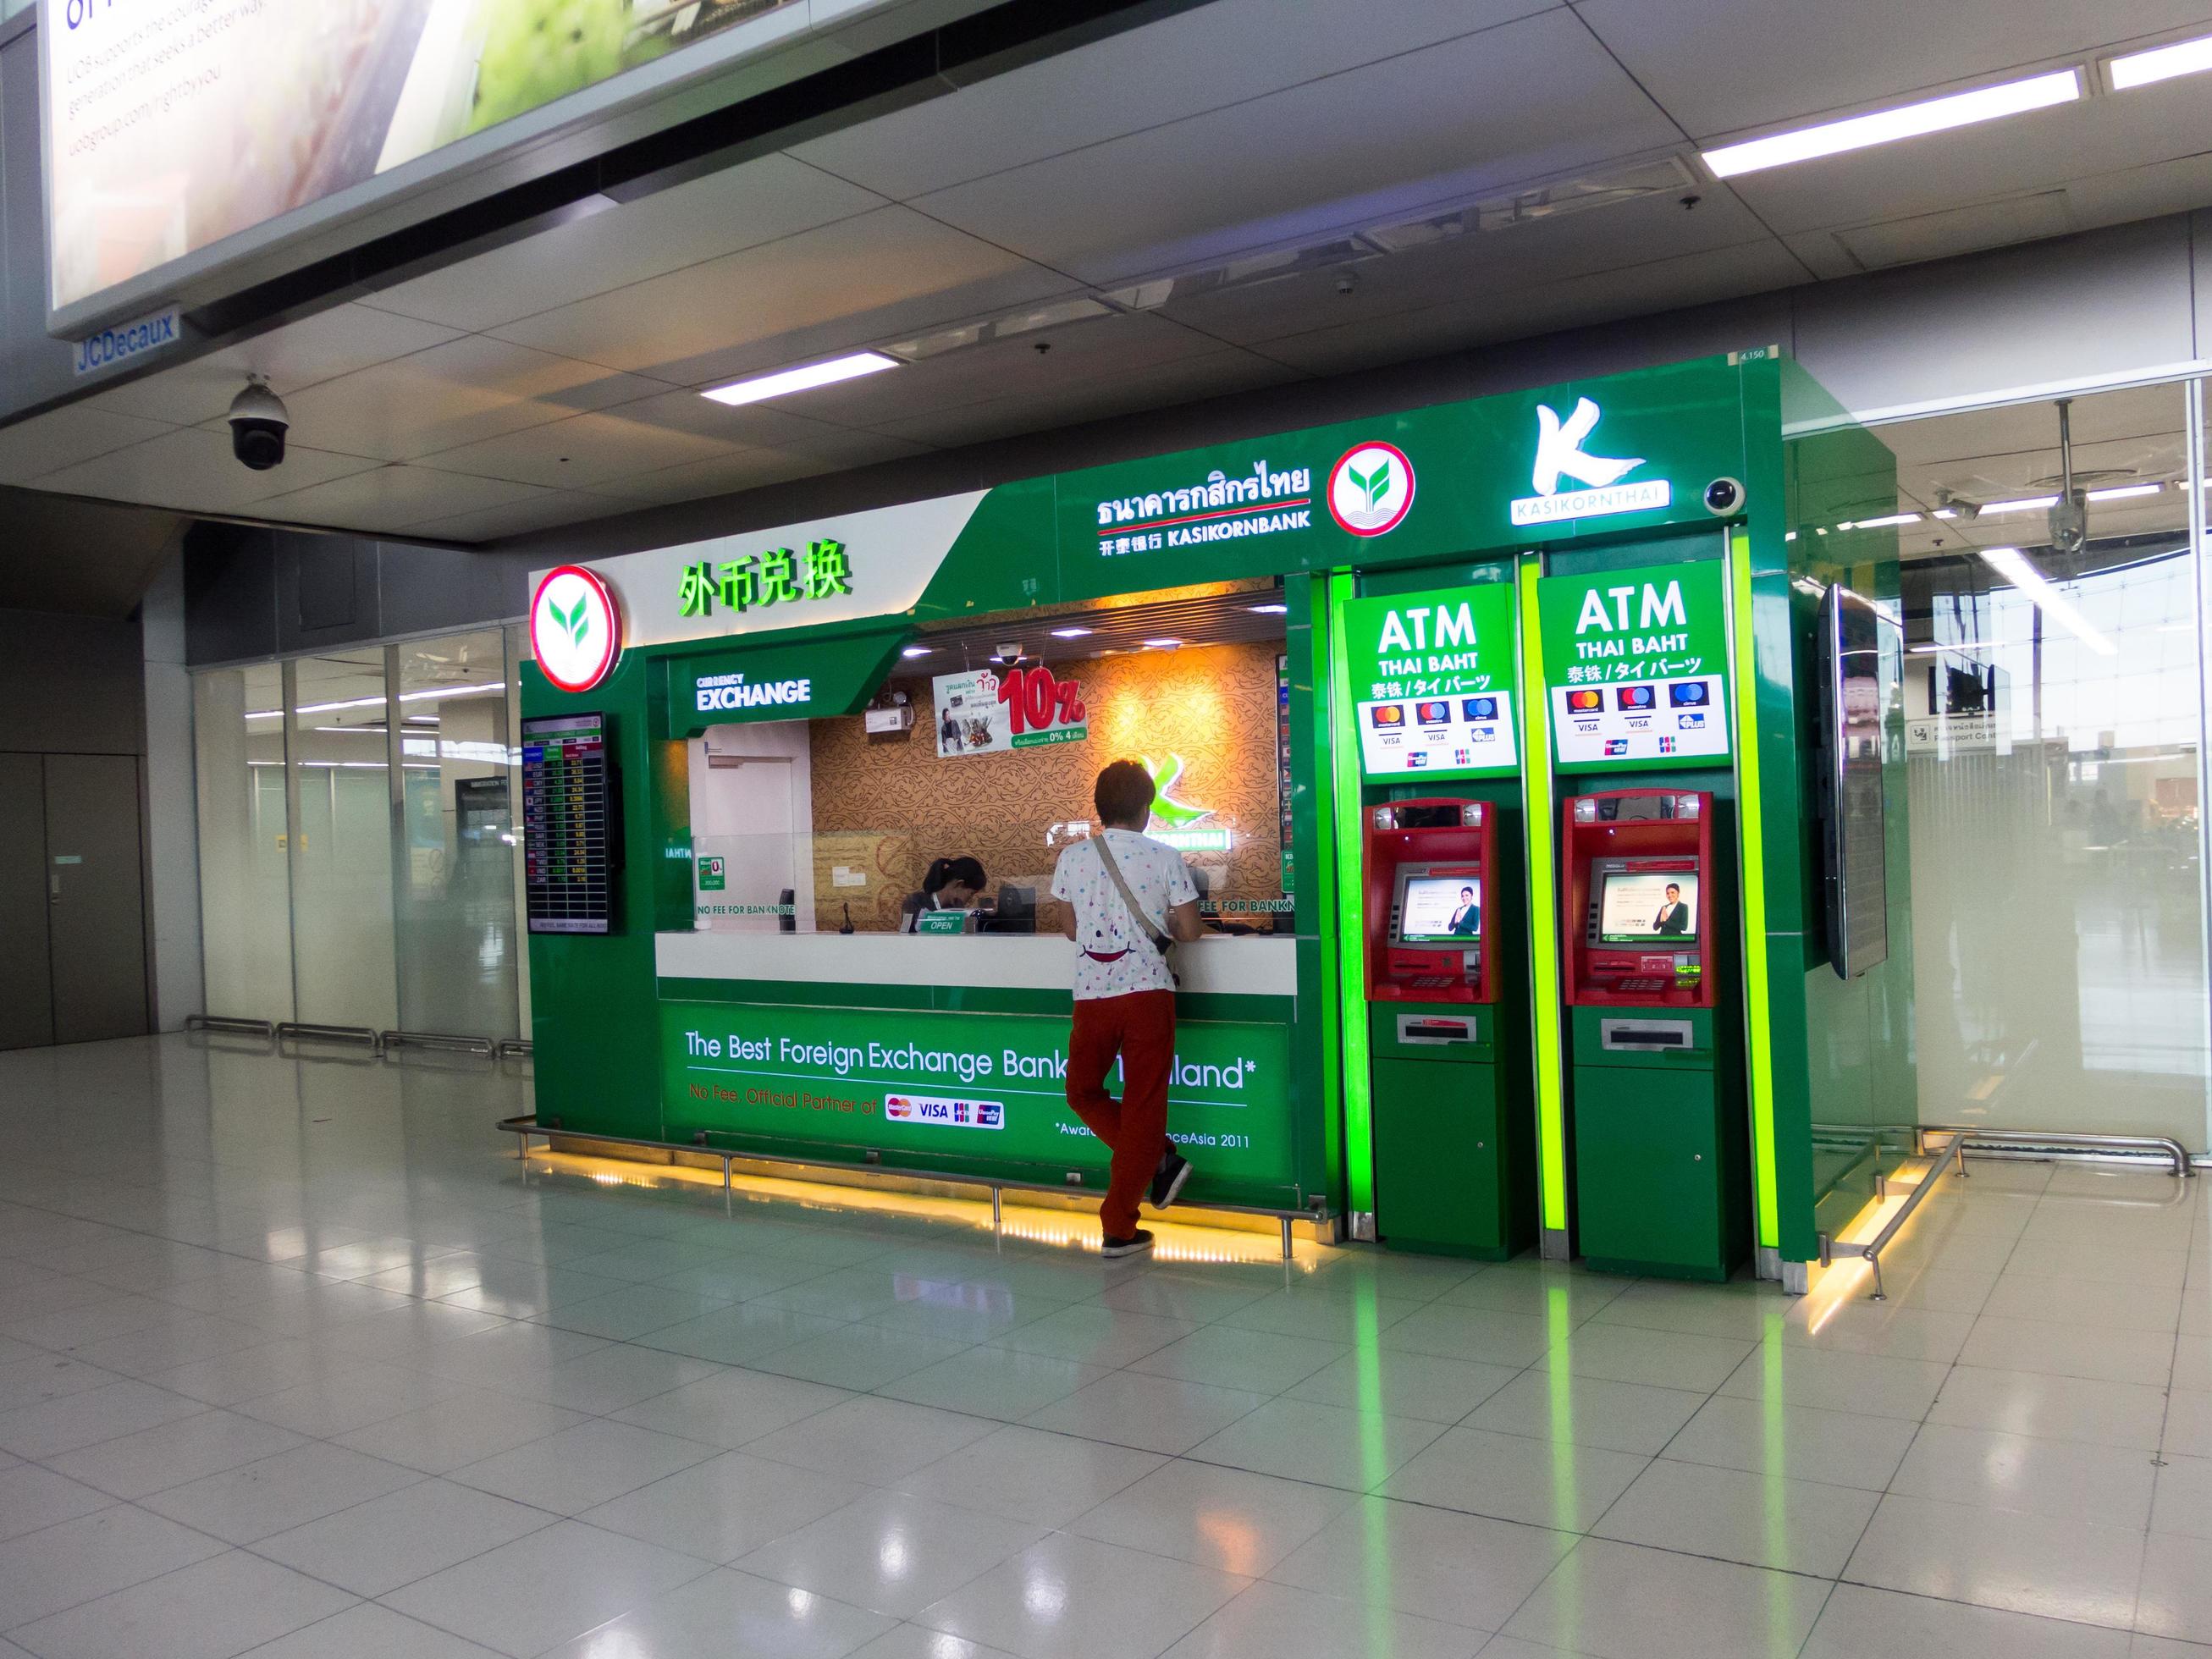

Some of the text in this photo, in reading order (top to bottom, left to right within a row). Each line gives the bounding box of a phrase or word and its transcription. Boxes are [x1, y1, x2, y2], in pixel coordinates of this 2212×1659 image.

[78, 316, 173, 371] JCDecaux
[1741, 350, 1764, 361] 4.150
[1097, 460, 1311, 526] ธนาคารกสิกรไทย
[1516, 486, 1659, 518] KASIKORNTHAI
[1167, 510, 1311, 548] KASIKORNBANK
[677, 538, 852, 617] 外币兑换
[1575, 580, 1687, 635] ATM
[1377, 602, 1477, 653] ATM
[1575, 633, 1689, 659] THAI BAHT
[1378, 652, 1479, 676] THAI BAHT
[697, 679, 811, 711] EXCHANGE
[997, 667, 1086, 735] 10%
[1578, 723, 1598, 732] VISA
[1629, 719, 1649, 728] VISA
[1382, 736, 1401, 745] VISA
[1427, 733, 1446, 741] VISA
[697, 905, 710, 915] NO
[713, 905, 726, 915] FEE
[729, 905, 745, 915] FOR
[1197, 899, 1295, 912] FEE FOR BANKN
[930, 921, 953, 931] OPEN
[685, 1030, 721, 1057] The
[728, 1034, 772, 1061] Best
[780, 1038, 863, 1075] Foreign
[869, 1042, 993, 1083] Exchange
[1003, 1050, 1068, 1079] Bank
[690, 1083, 709, 1100] No
[746, 1088, 797, 1108] Official
[803, 1093, 856, 1113] Partner
[860, 1099, 877, 1116] of
[919, 1103, 949, 1118] VISA
[1221, 1134, 1249, 1149] 2011
